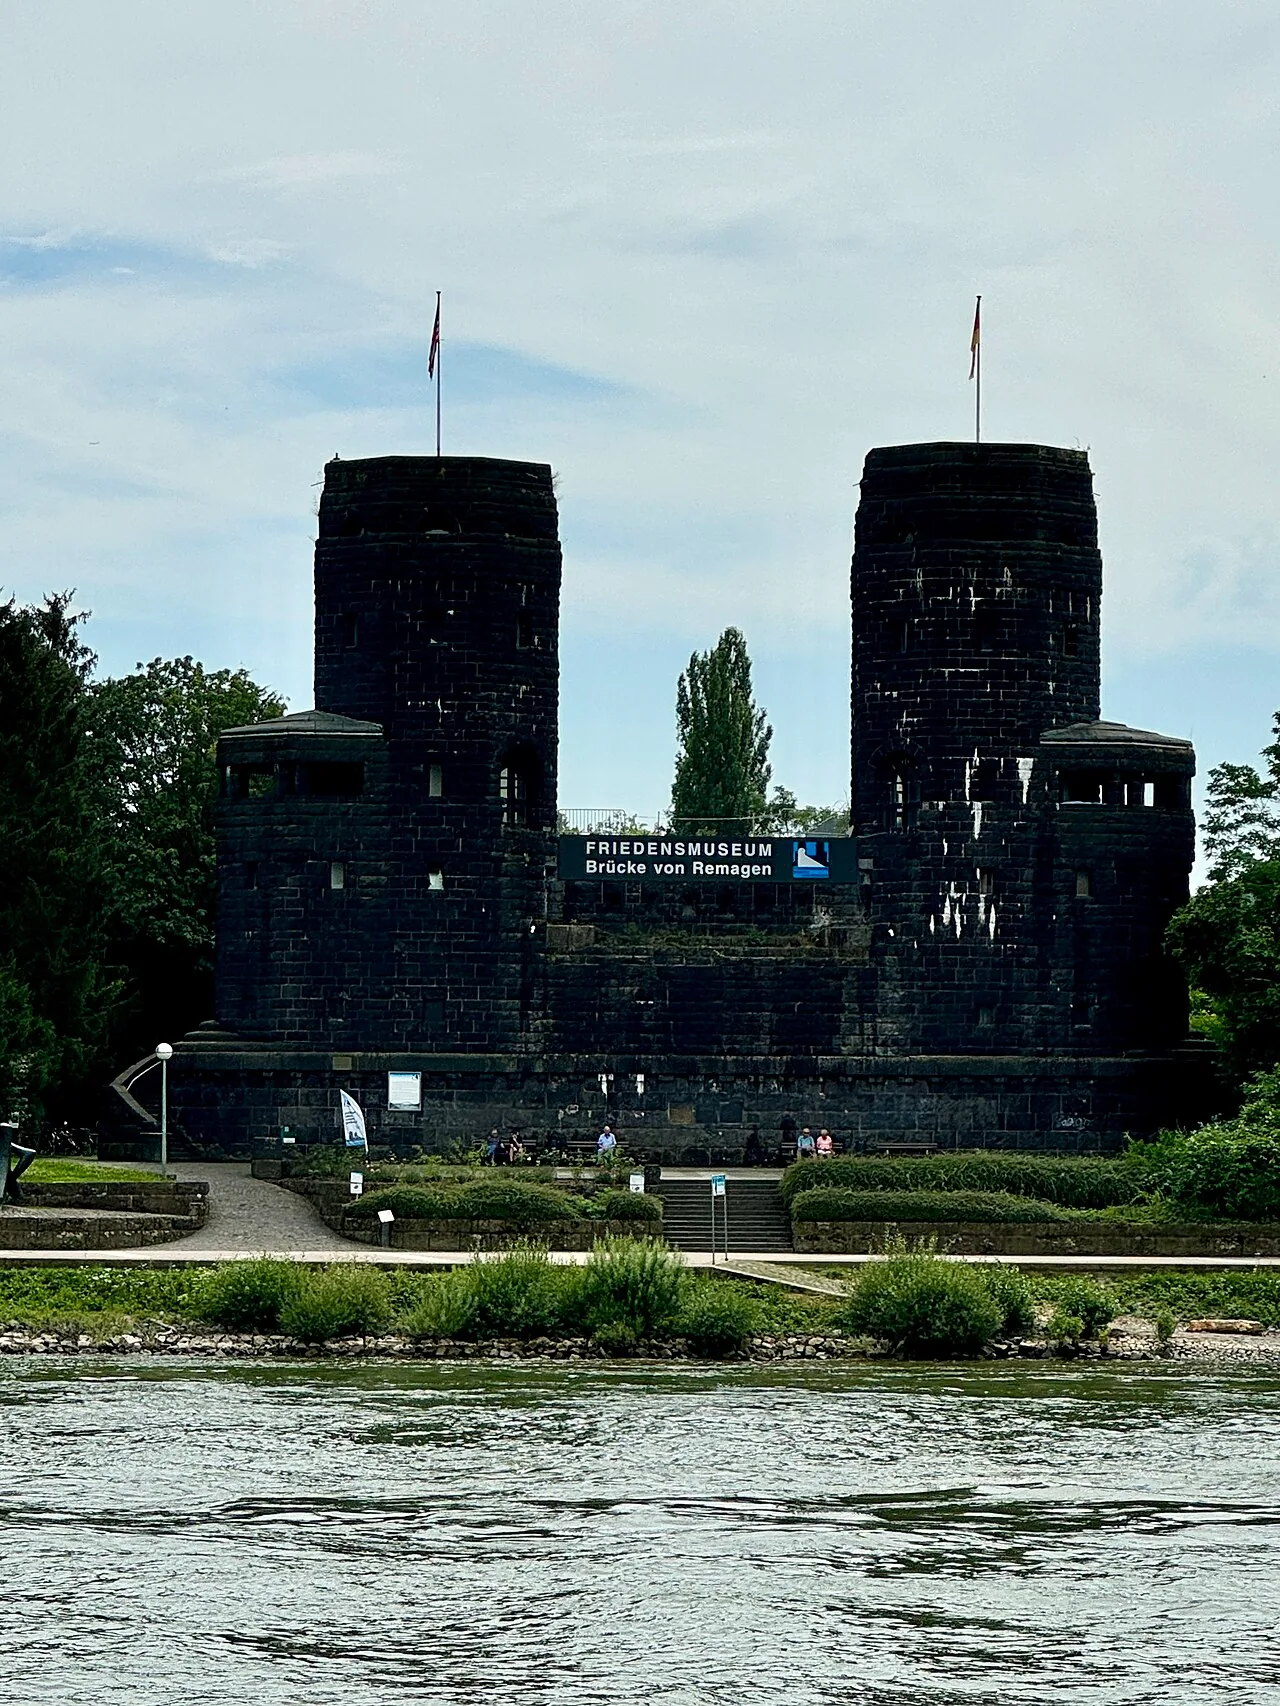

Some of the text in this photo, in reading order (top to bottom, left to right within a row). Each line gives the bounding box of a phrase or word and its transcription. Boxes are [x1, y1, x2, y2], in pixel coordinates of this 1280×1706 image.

[586, 841, 773, 857] FRIEDENSMUSEUM
[586, 859, 773, 879] Brücke von Remagen
